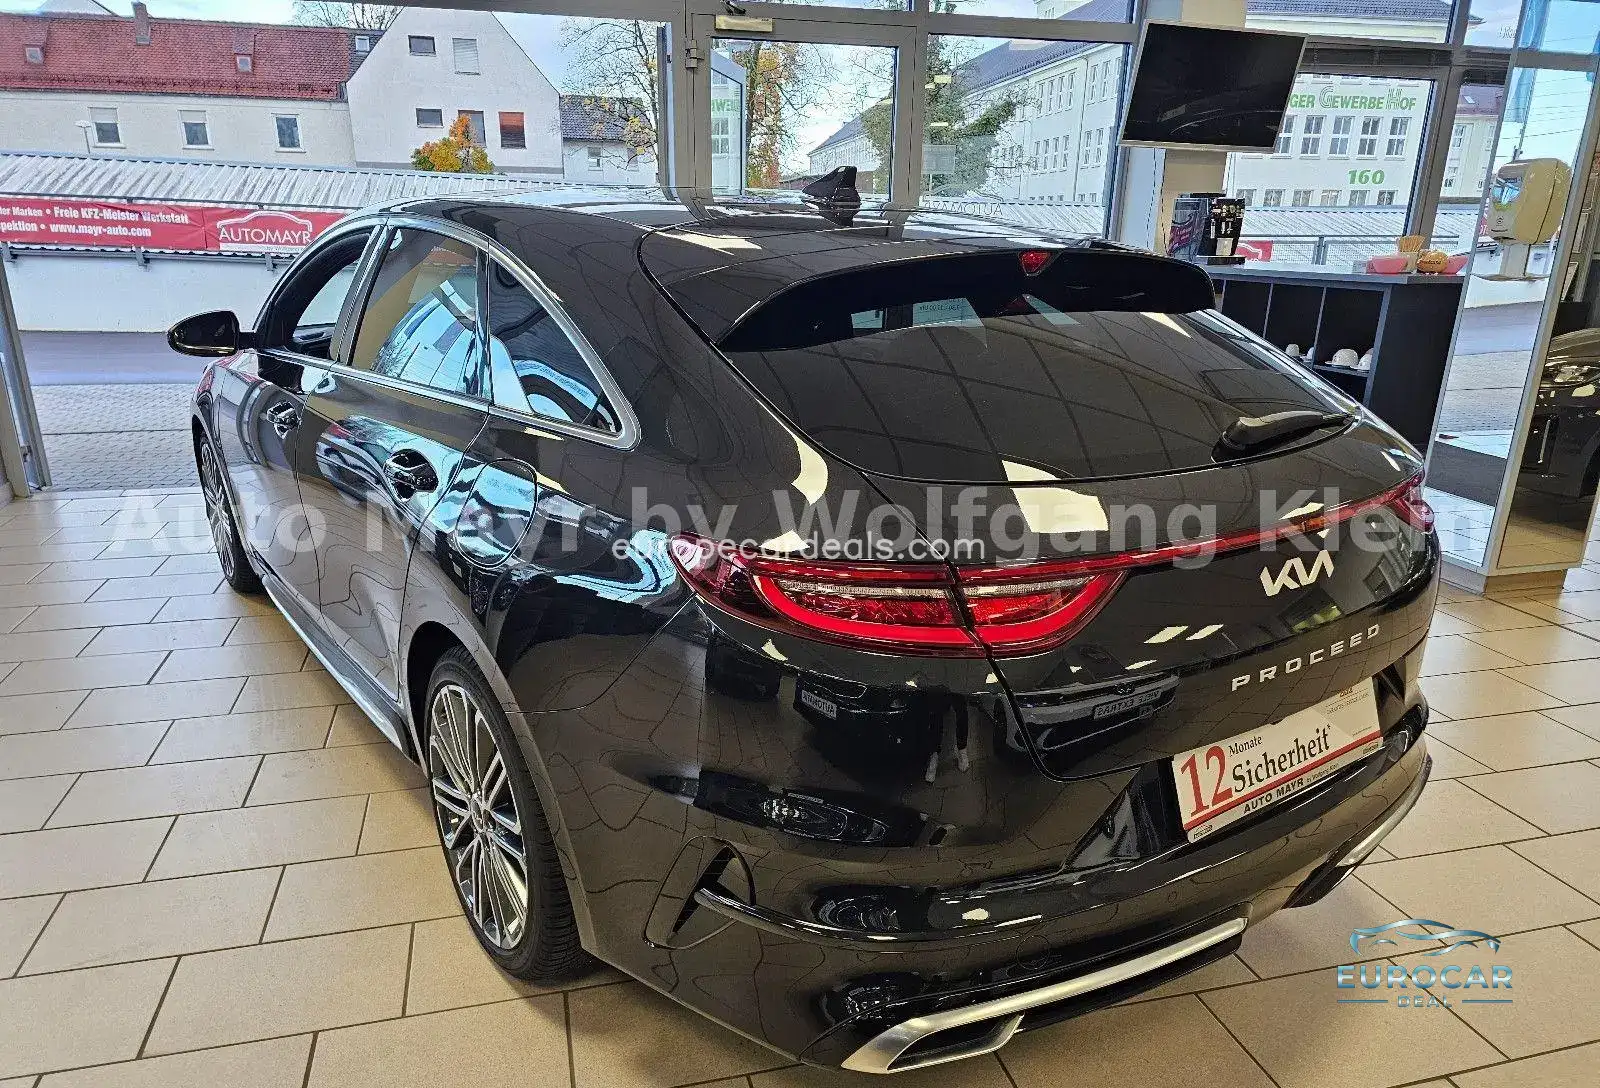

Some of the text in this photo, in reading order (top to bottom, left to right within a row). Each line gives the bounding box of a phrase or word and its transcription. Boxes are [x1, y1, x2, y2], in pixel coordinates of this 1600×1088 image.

[1290, 86, 1416, 111] GER GEWERBE HOF
[1348, 169, 1385, 185] 160
[12, 206, 43, 217] Marken
[54, 207, 78, 218] Freie
[81, 207, 139, 221] KFZ-Meister
[142, 212, 189, 225] Werkstatt
[50, 223, 152, 238] www.mayr-auto.com
[219, 228, 312, 244] AUTOMAYR
[1231, 623, 1380, 692] PROCEED
[1180, 735, 1262, 818] 12 Monate
[1243, 793, 1273, 813] AUTO
[1276, 778, 1304, 797] MAYR
